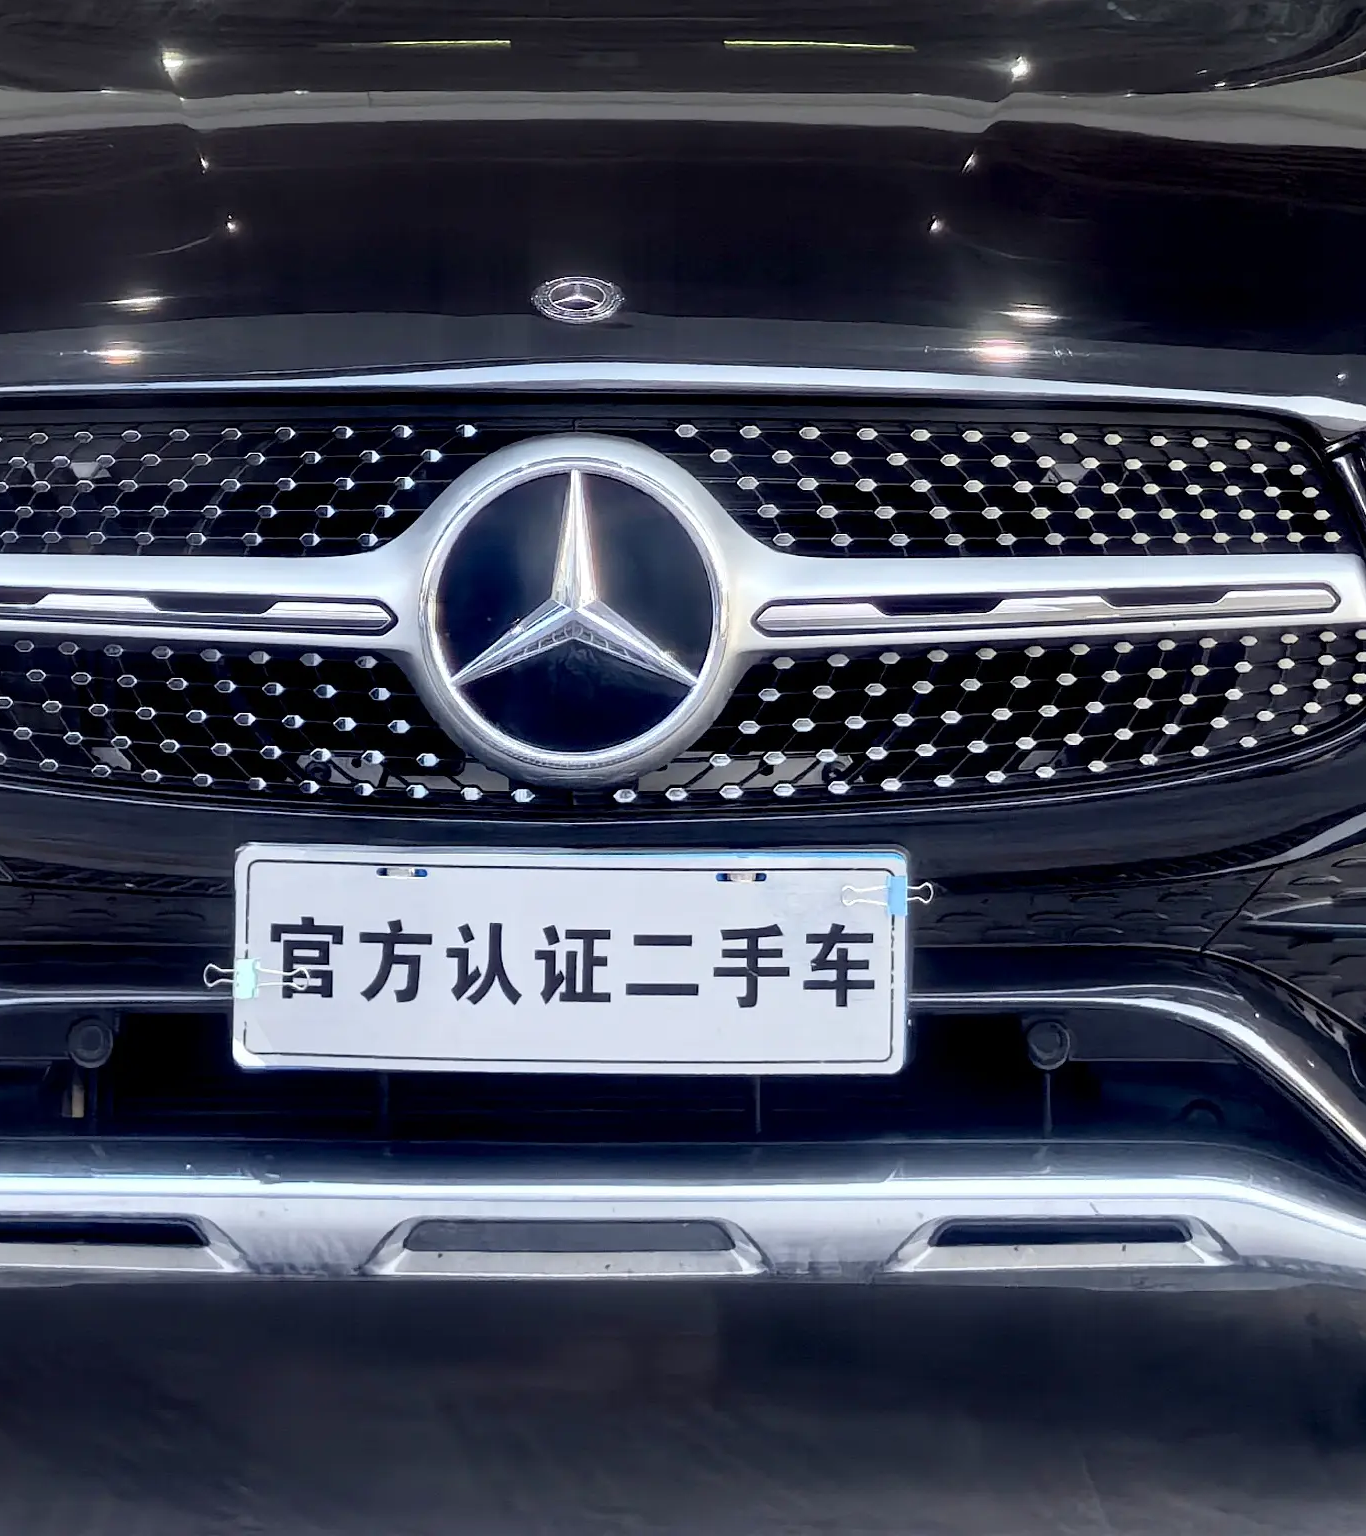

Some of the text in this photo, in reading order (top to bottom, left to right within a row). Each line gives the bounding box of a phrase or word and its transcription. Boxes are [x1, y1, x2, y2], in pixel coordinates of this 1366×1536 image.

[269, 916, 877, 1008] 官方认证二手车
